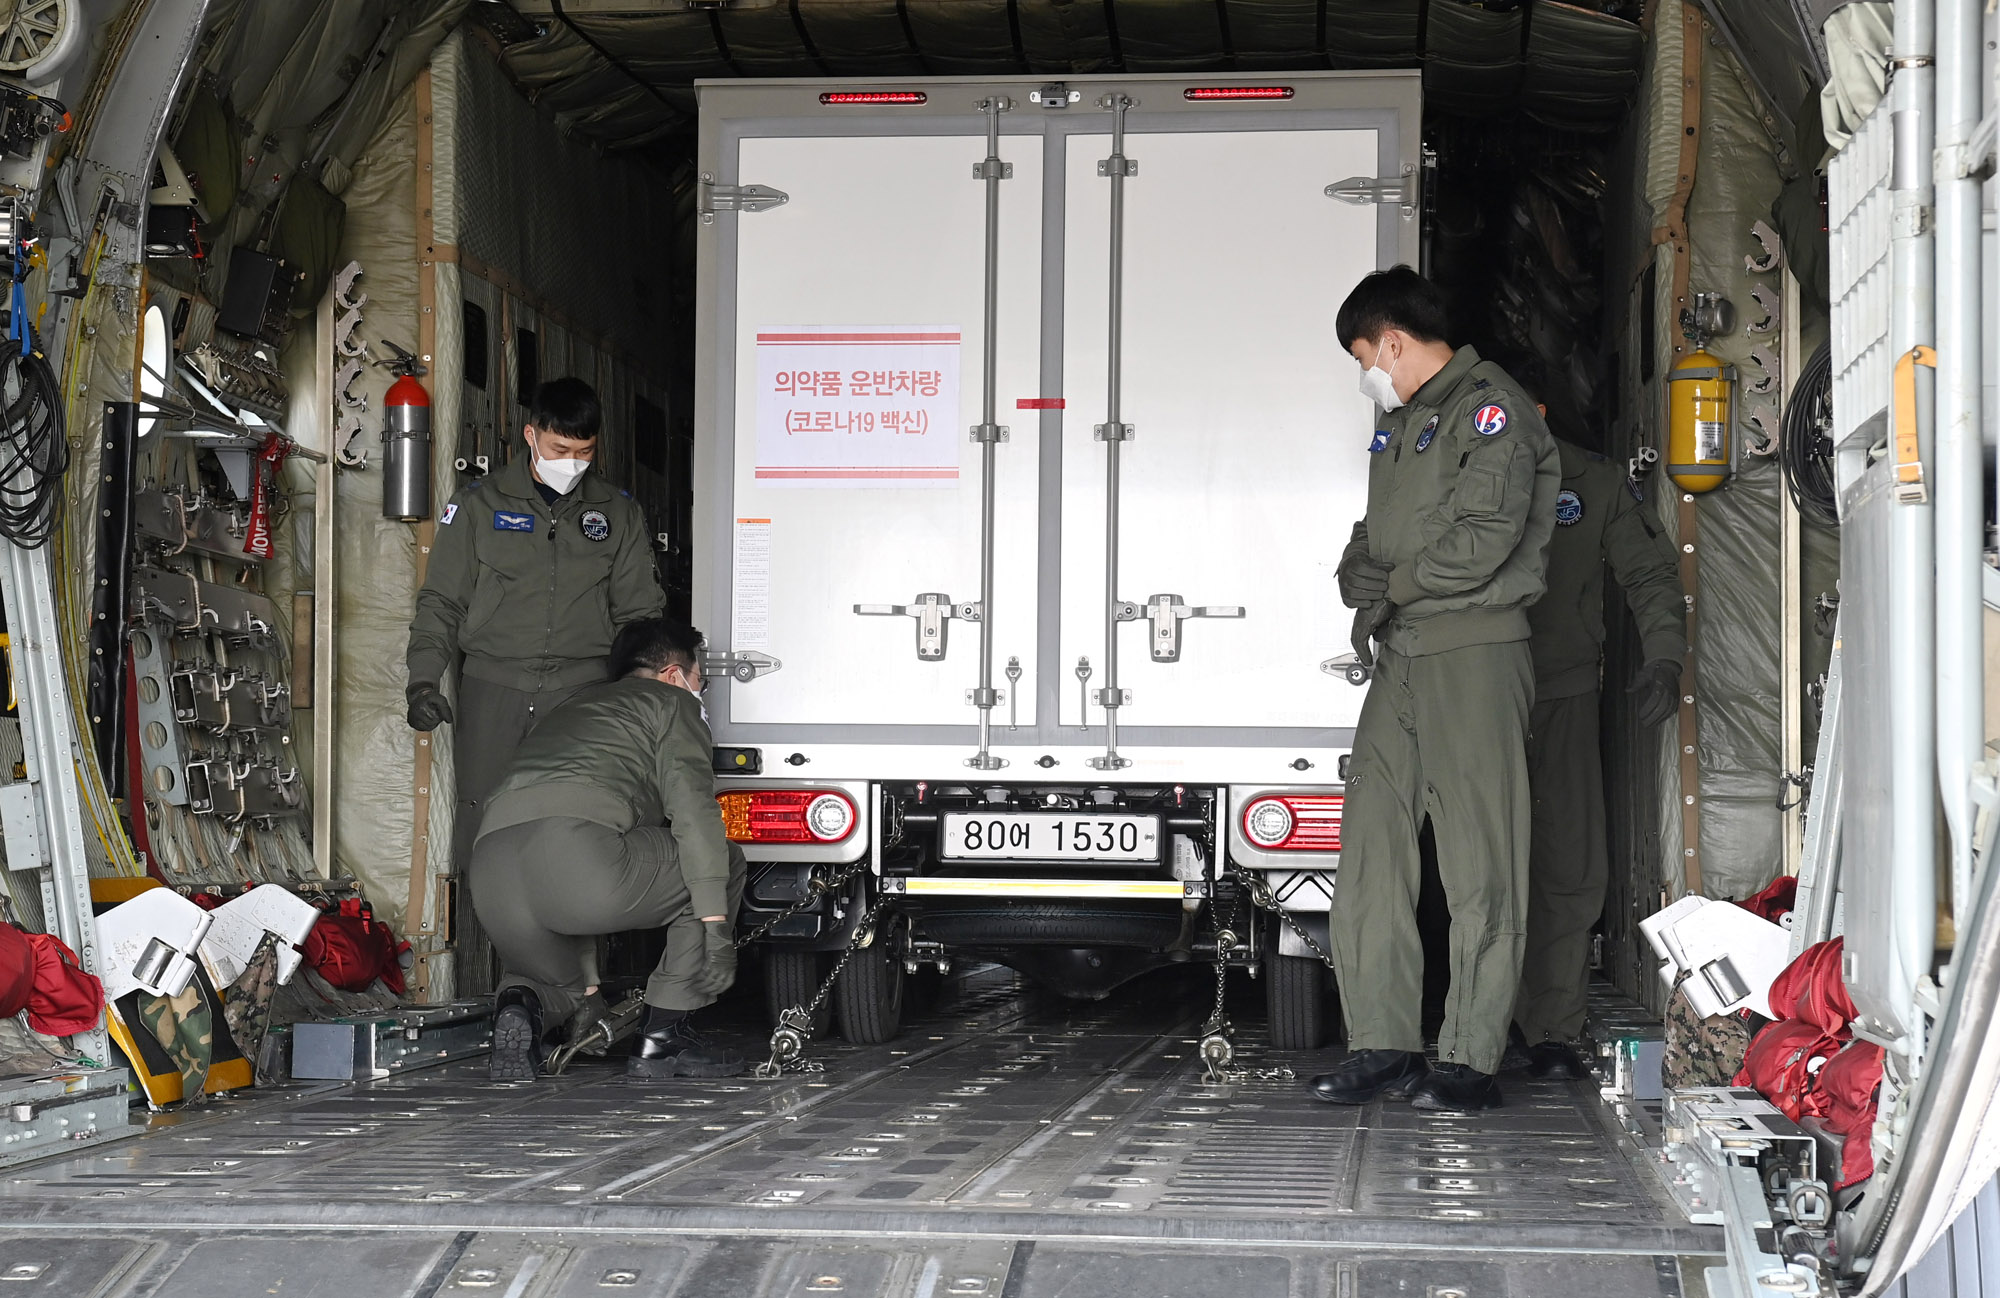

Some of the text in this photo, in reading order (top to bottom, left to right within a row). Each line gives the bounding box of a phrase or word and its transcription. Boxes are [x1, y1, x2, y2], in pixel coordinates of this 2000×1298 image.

[774, 370, 942, 397] 의약품 운반차량
[785, 409, 929, 435] (코로나19 백신)
[964, 820, 1138, 852] 80어 1530
